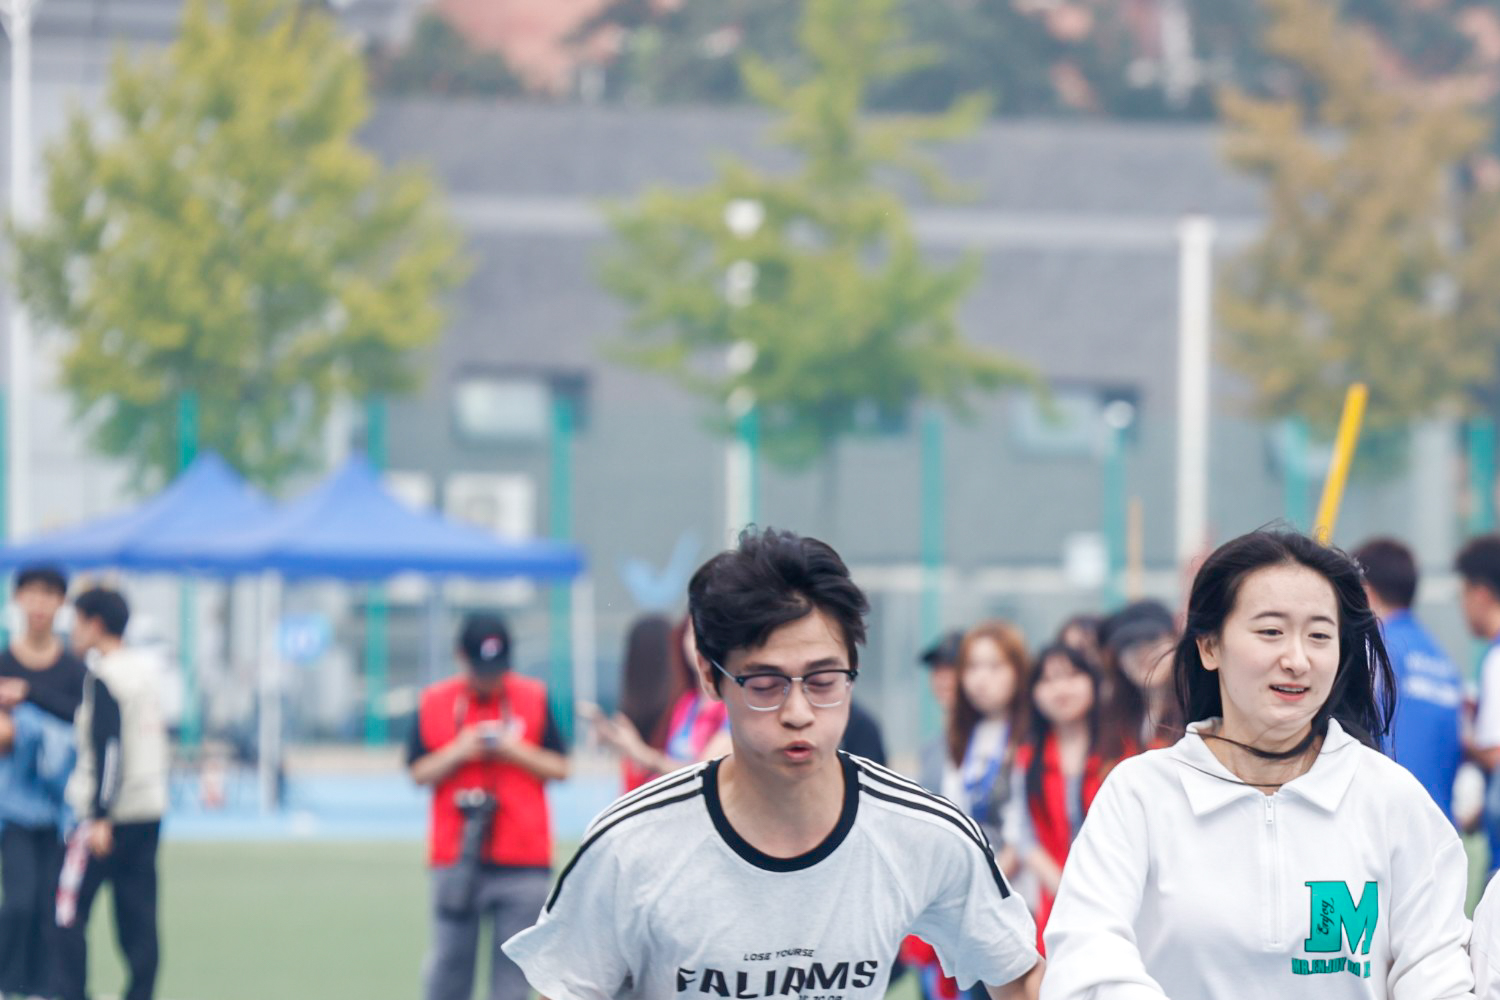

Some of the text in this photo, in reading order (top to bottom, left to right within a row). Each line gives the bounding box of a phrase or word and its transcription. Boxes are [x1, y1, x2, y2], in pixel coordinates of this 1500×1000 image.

[1304, 880, 1379, 955] M
[1316, 896, 1335, 936] Enjoy
[743, 952, 771, 961] LOSE
